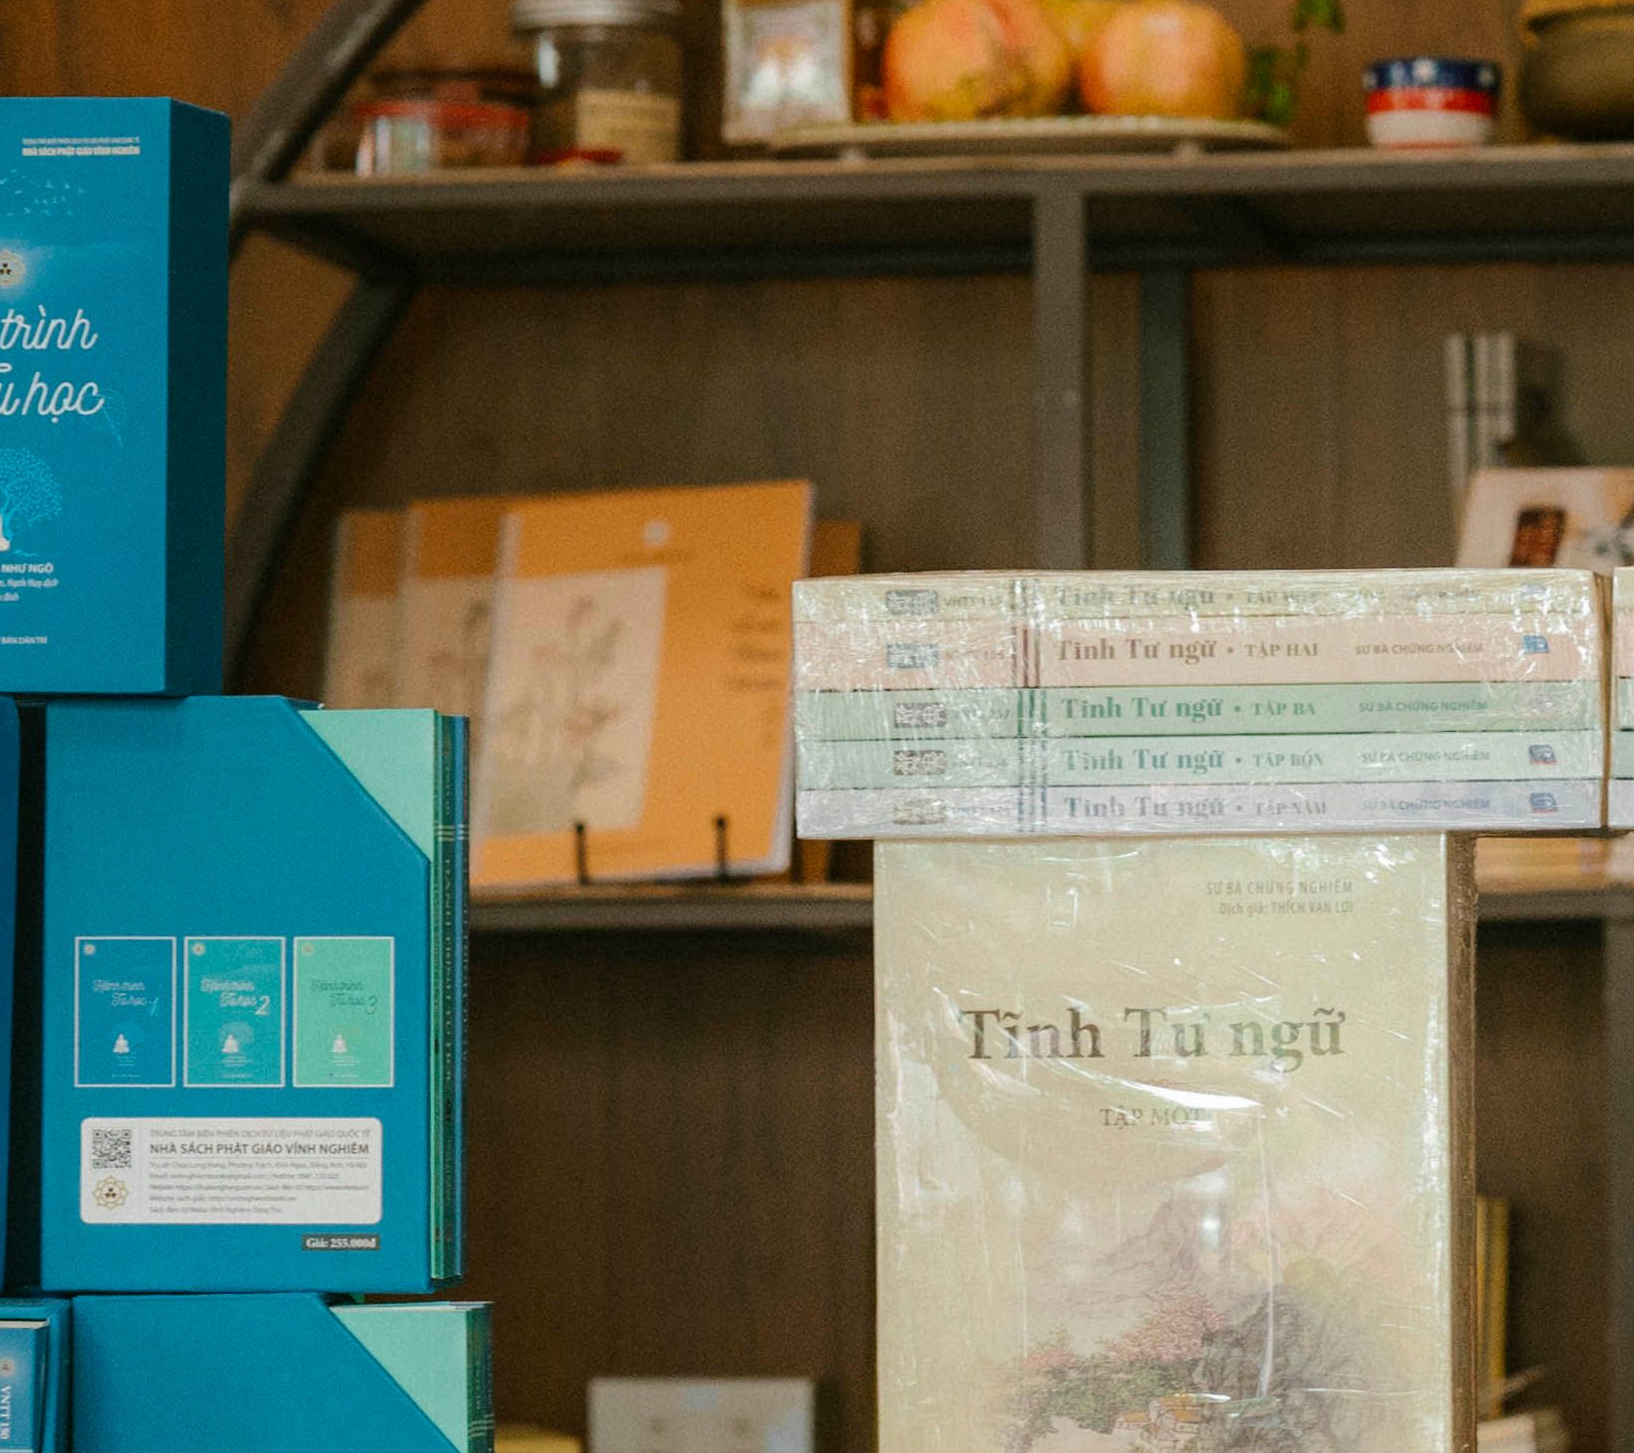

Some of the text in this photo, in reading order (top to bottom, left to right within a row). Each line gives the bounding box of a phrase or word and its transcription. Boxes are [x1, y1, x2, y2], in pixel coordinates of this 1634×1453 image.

[21, 371, 106, 424] học
[1293, 701, 1316, 714] BA
[958, 1006, 1347, 1075] Tĩnh Tư ngữ
